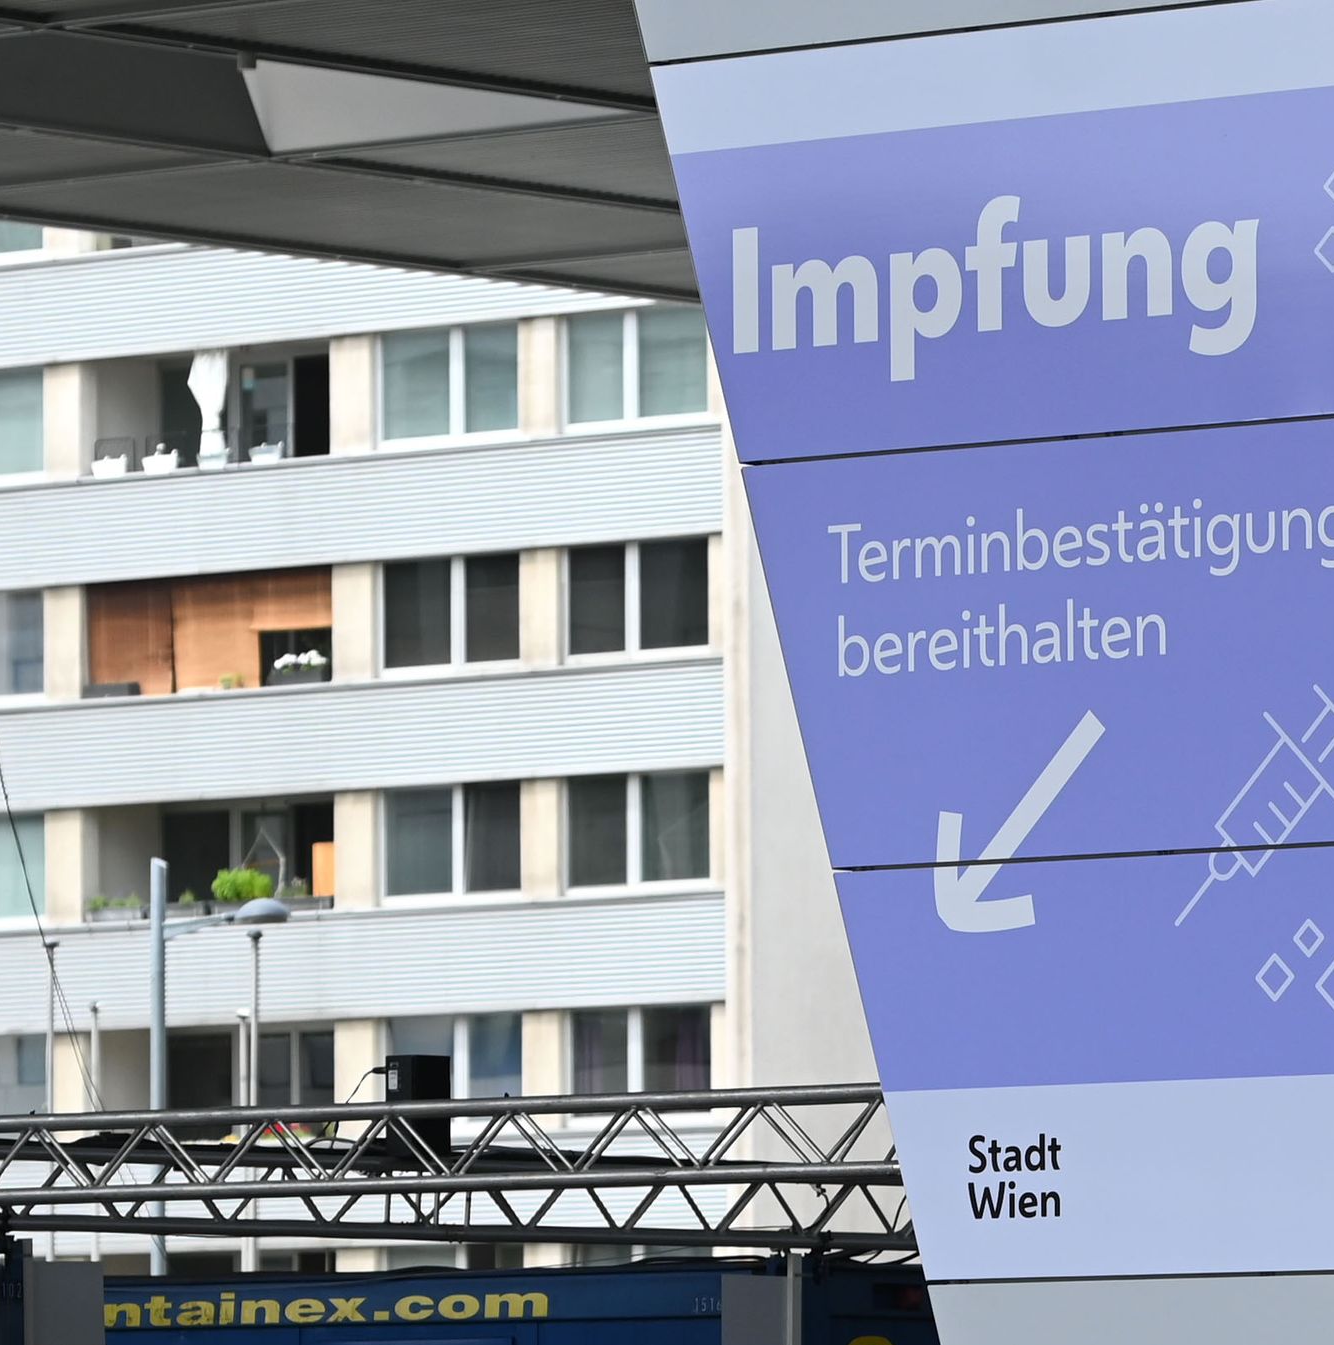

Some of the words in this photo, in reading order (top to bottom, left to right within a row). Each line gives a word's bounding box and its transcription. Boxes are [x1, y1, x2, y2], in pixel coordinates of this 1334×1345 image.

[731, 195, 1260, 383] Impfung
[837, 599, 1167, 678] bereithalten
[968, 1133, 1062, 1174] Stadt
[967, 1180, 1061, 1220] Wien
